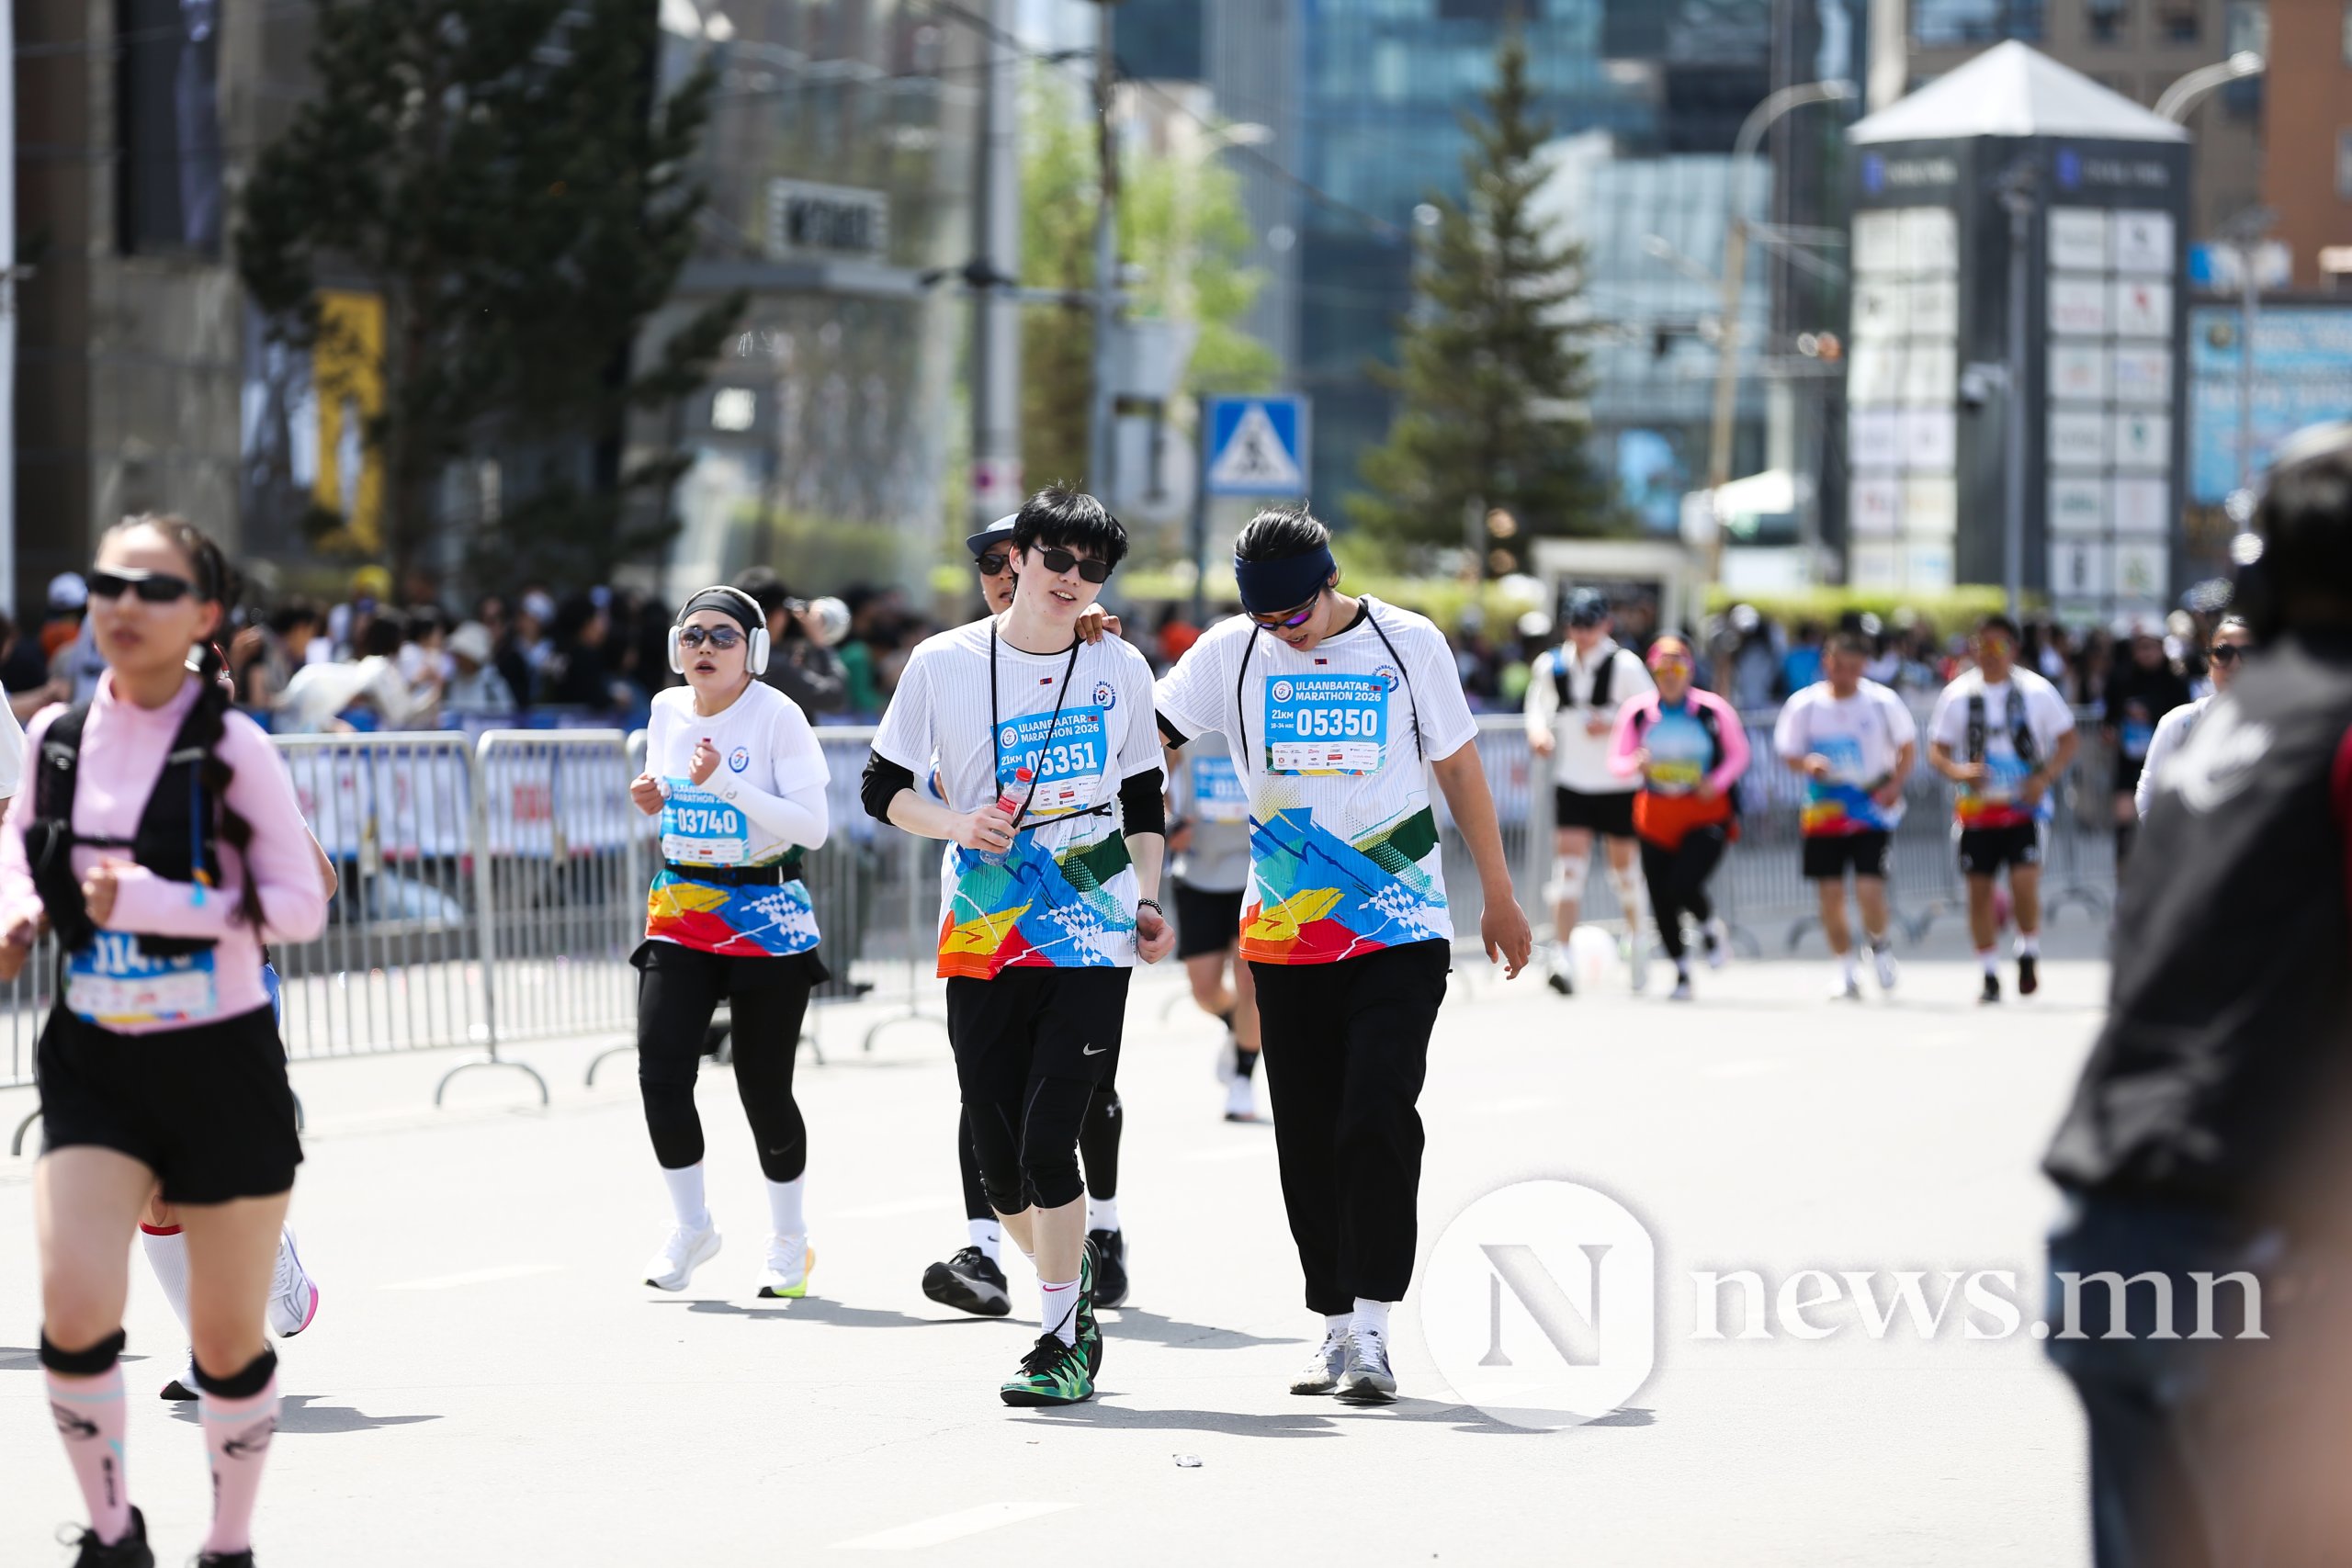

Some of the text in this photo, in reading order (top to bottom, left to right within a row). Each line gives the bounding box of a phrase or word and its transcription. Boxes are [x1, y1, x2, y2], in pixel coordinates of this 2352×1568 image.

[1295, 682, 1370, 691] ULAANBAATAR
[1295, 692, 1382, 702] MARATHON 2026
[1018, 715, 1088, 733] ULAANBAATAR
[1296, 708, 1378, 737] 05350
[1021, 727, 1073, 743] MARATHON
[1075, 723, 1100, 735] 2026
[1025, 742, 1097, 778] 05351
[677, 807, 738, 834] 03740
